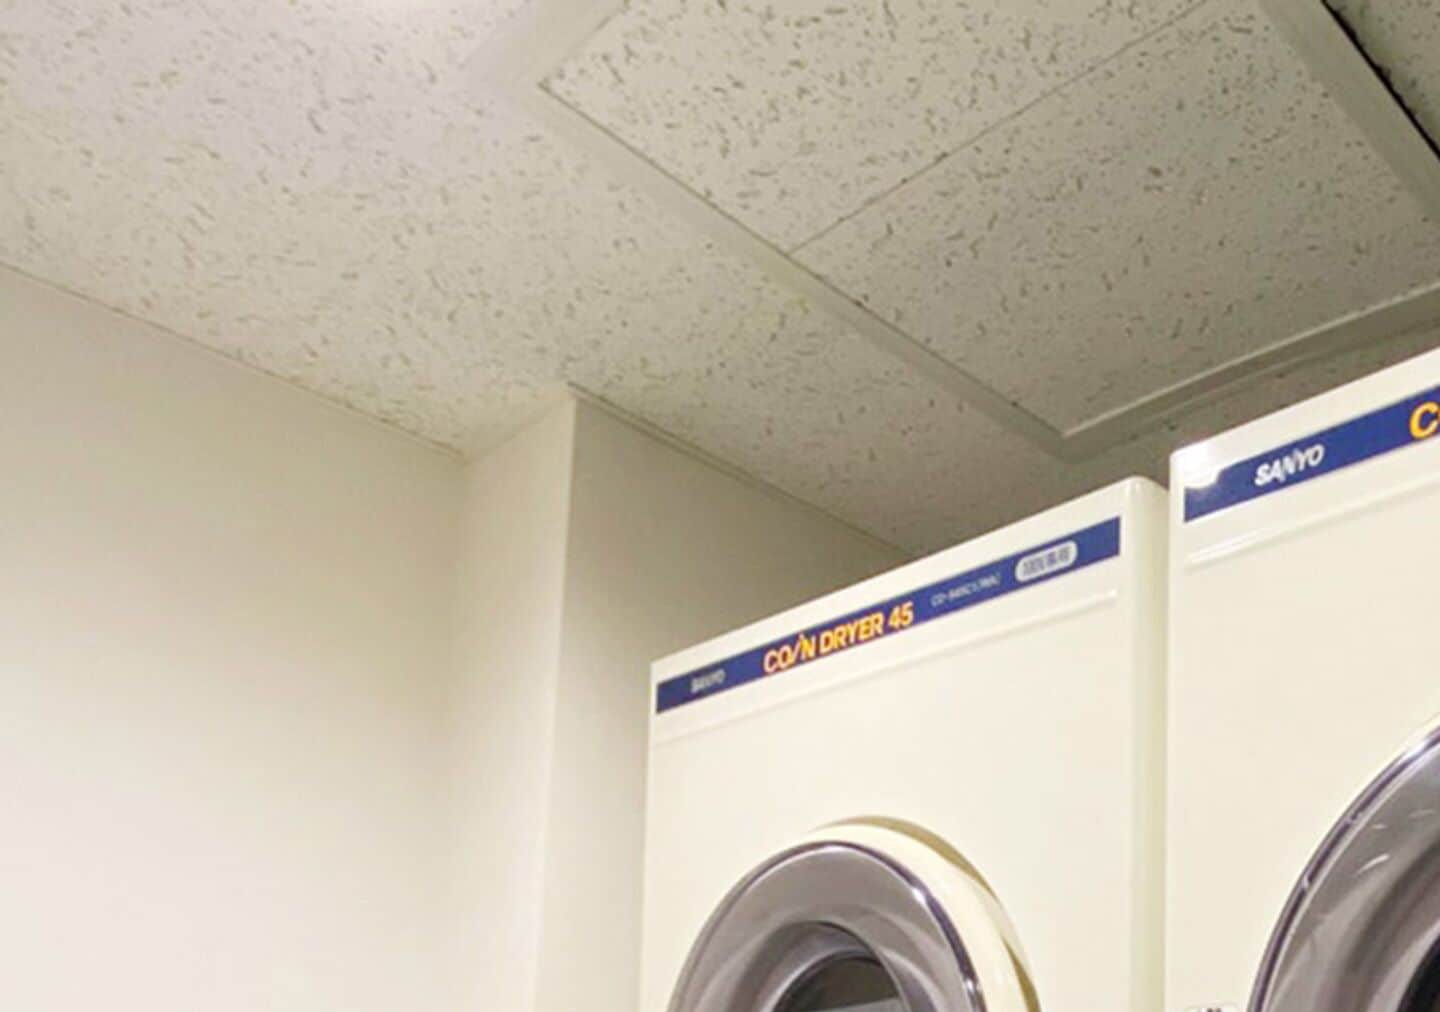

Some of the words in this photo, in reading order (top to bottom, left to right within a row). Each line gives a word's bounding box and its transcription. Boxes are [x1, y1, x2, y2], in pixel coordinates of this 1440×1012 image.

[1254, 445, 1326, 486] SANYO
[819, 612, 884, 654] DRYER
[888, 601, 914, 630] 45
